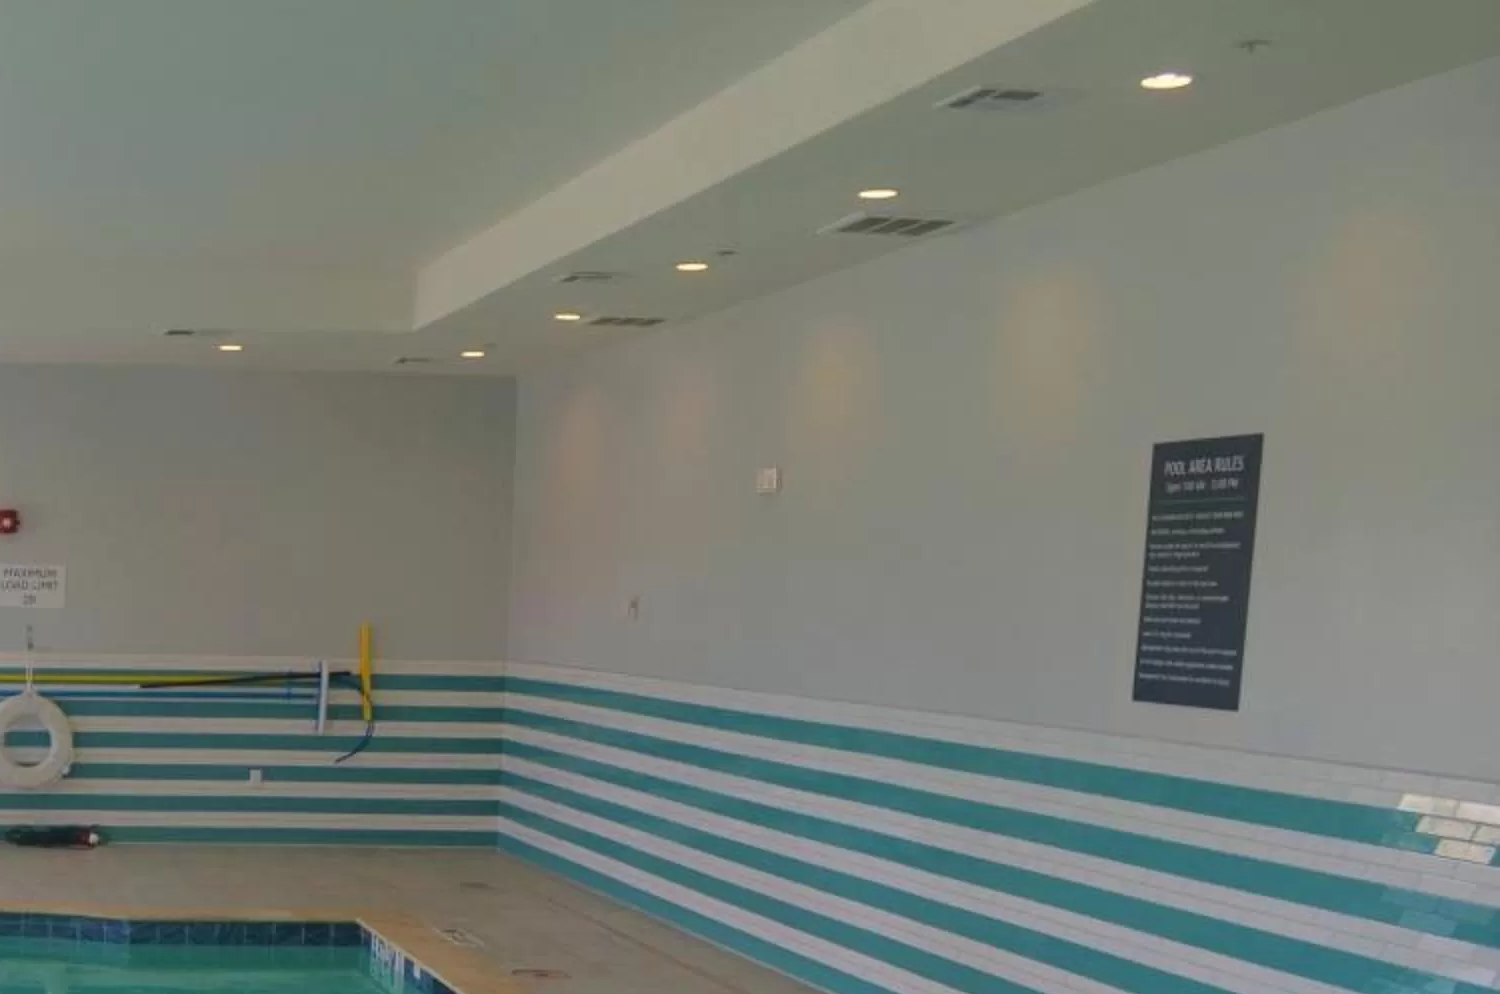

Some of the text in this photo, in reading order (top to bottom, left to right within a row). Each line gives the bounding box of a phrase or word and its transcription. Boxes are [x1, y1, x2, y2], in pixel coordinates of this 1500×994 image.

[1164, 456, 1244, 476] POOL AREA RULES
